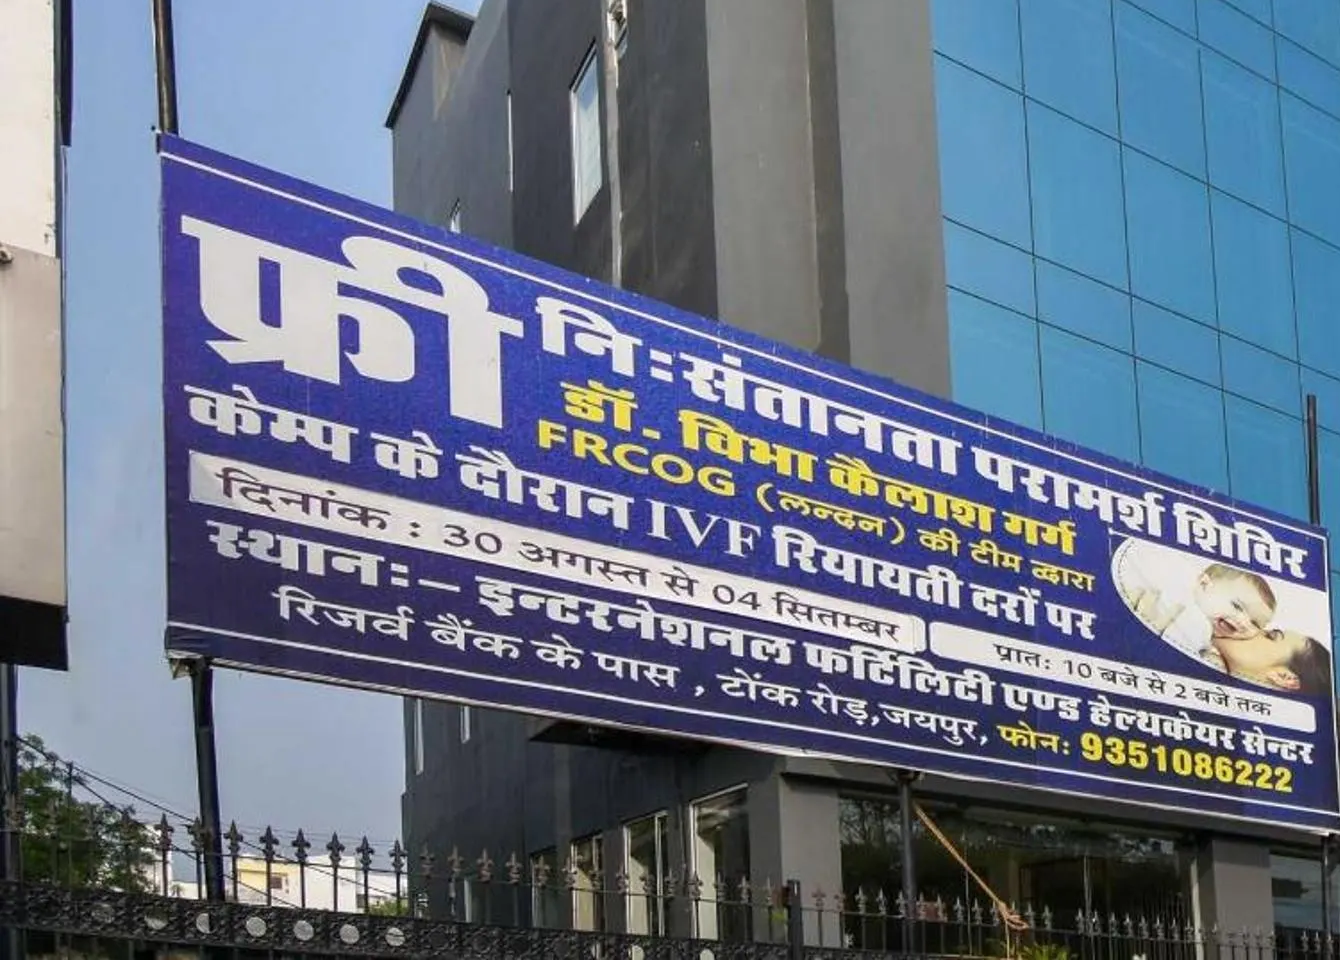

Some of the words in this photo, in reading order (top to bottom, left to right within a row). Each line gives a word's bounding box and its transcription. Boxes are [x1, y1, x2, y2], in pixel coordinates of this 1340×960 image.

[181, 215, 524, 428] फ्री
[184, 384, 359, 464] केम्प
[371, 430, 443, 479] के
[455, 445, 634, 530] दौरान
[645, 498, 761, 558] IVF
[772, 524, 963, 609] रियायती
[969, 584, 1041, 627] दरों
[1044, 601, 1097, 640] पर
[538, 419, 735, 496] FRCOG
[756, 482, 905, 544] (लन्दन)
[917, 528, 961, 556] की
[969, 540, 1022, 573] टीम
[678, 409, 817, 482] विभा
[826, 453, 995, 532] कैलाश
[1002, 511, 1076, 555] गर्ग
[970, 446, 1166, 537] परामर्श
[1172, 503, 1307, 578] शिविर
[443, 523, 502, 554] 30
[518, 541, 650, 588] अगस्त
[660, 565, 699, 597] से
[712, 584, 760, 611] 04
[771, 591, 900, 642] सितम्बर
[271, 585, 414, 640] रिजर्व
[425, 613, 524, 660] बैंक
[530, 633, 584, 670] के
[716, 667, 801, 707] टोंक
[1080, 732, 1293, 793] 9351086222
[475, 575, 796, 666] इन्टरनेशनल
[803, 643, 997, 705] फर्टिलिटी
[1002, 682, 1081, 721] एण्ड
[1088, 695, 1236, 751] हेल्थकेयर
[1242, 724, 1313, 764] सेन्टर
[1063, 659, 1092, 679] 10
[1100, 665, 1139, 692] बजे
[1144, 671, 1165, 695] से
[1175, 683, 1185, 698] 2
[1193, 686, 1230, 708] बजे
[1235, 695, 1271, 716] तक
